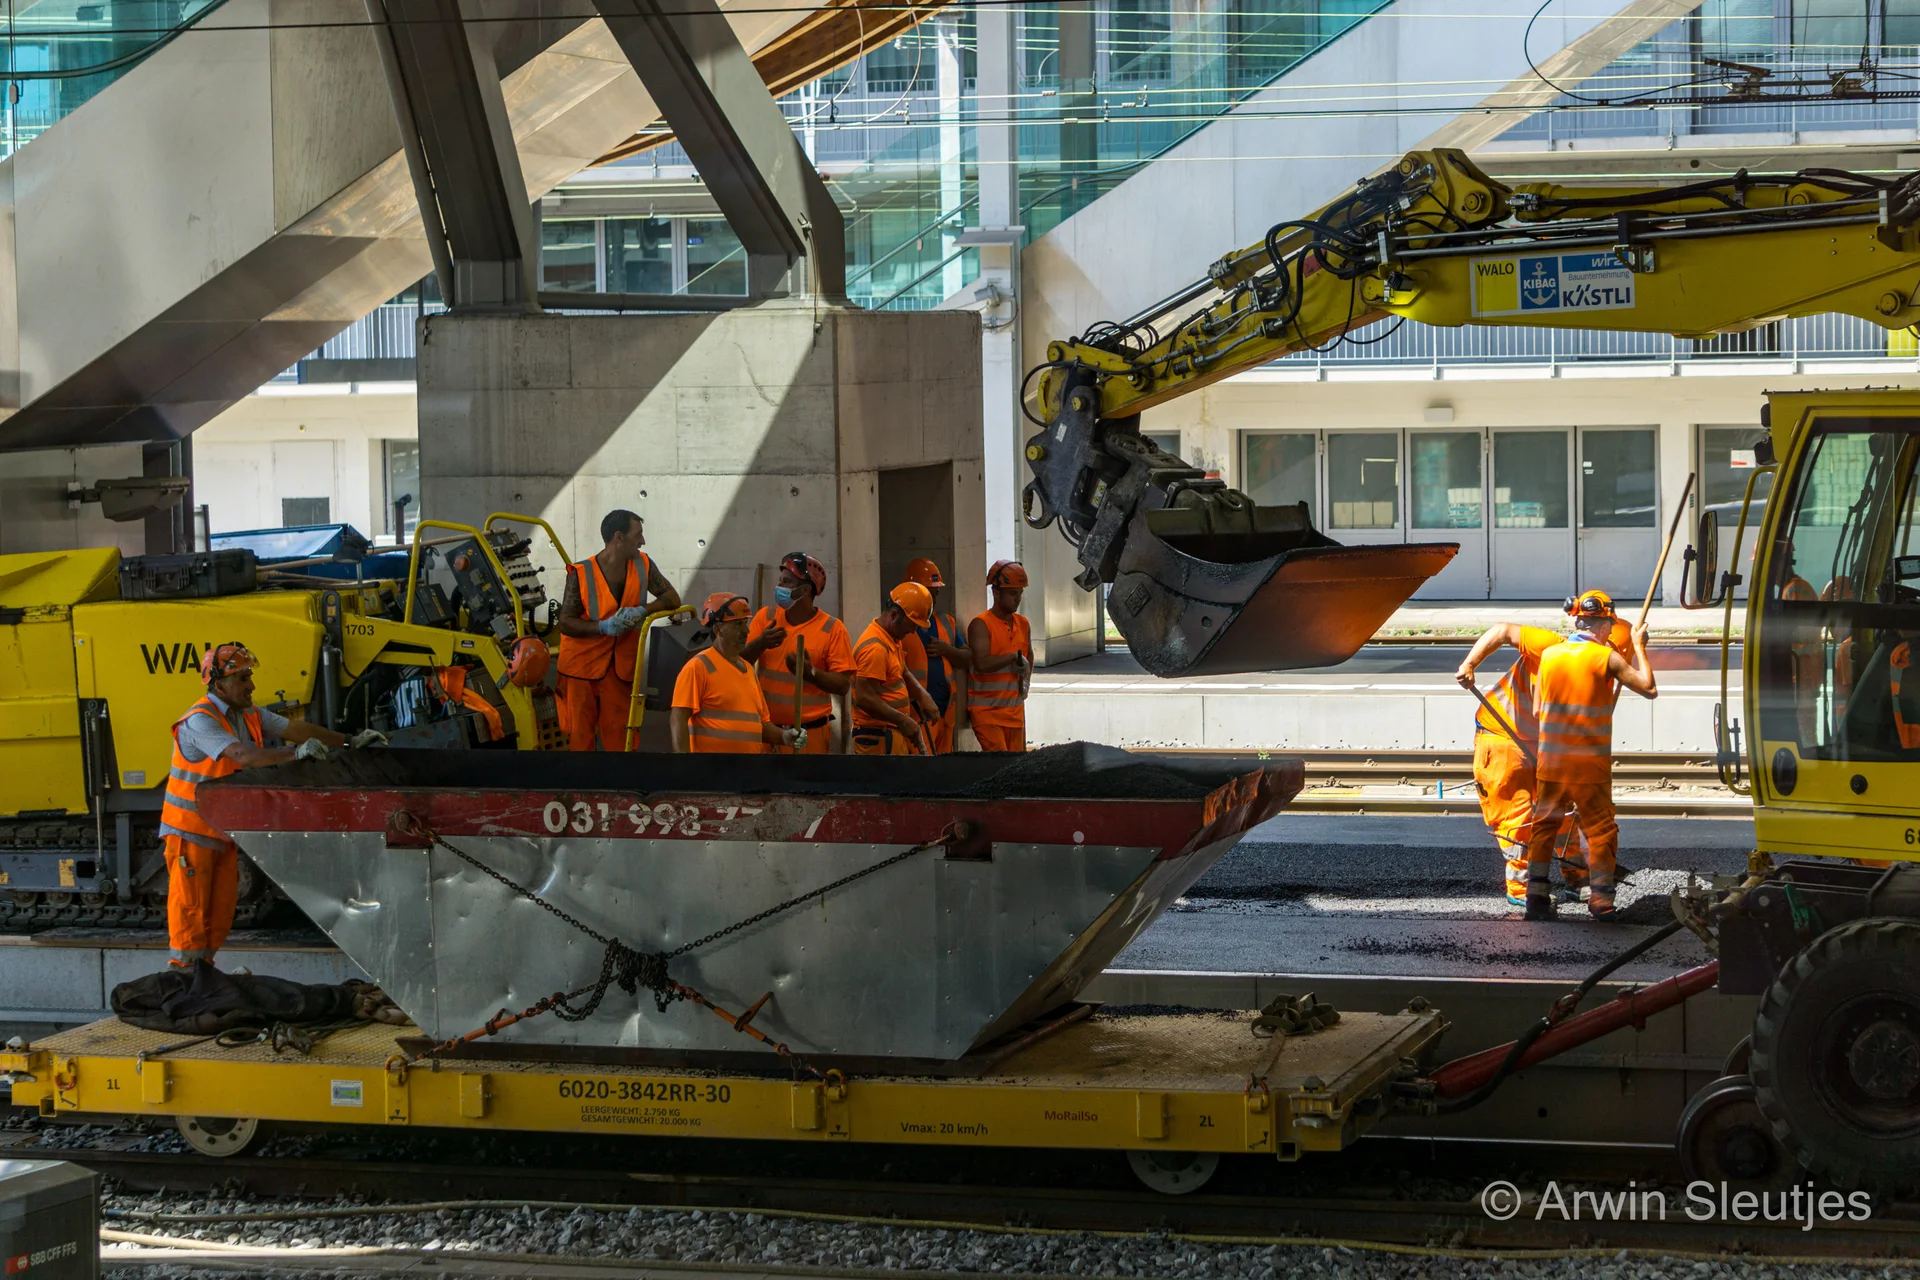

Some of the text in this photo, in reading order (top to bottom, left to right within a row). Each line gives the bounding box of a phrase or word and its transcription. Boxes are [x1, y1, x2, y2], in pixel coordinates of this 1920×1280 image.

[1477, 263, 1514, 276] WALO
[1568, 271, 1630, 281] Bauunternehmung
[1523, 278, 1556, 289] KIBAG
[1563, 284, 1631, 307] KÄSTLI
[345, 624, 375, 636] 1703
[543, 801, 609, 833] 031
[628, 803, 701, 836] 998
[106, 1078, 121, 1090] 1L
[559, 1079, 731, 1103] 6020-3842RR-30
[581, 1106, 681, 1117] LEERGEWICHT: 2.750 KG
[1044, 1110, 1098, 1122] MoRailSo
[581, 1115, 702, 1127] GESAMTGEWICHT: 20.000 KG
[1200, 1114, 1215, 1127] 2L
[901, 1122, 988, 1136] Vmax: 20 km/h
[30, 1241, 77, 1267] SBB CFF FFS
